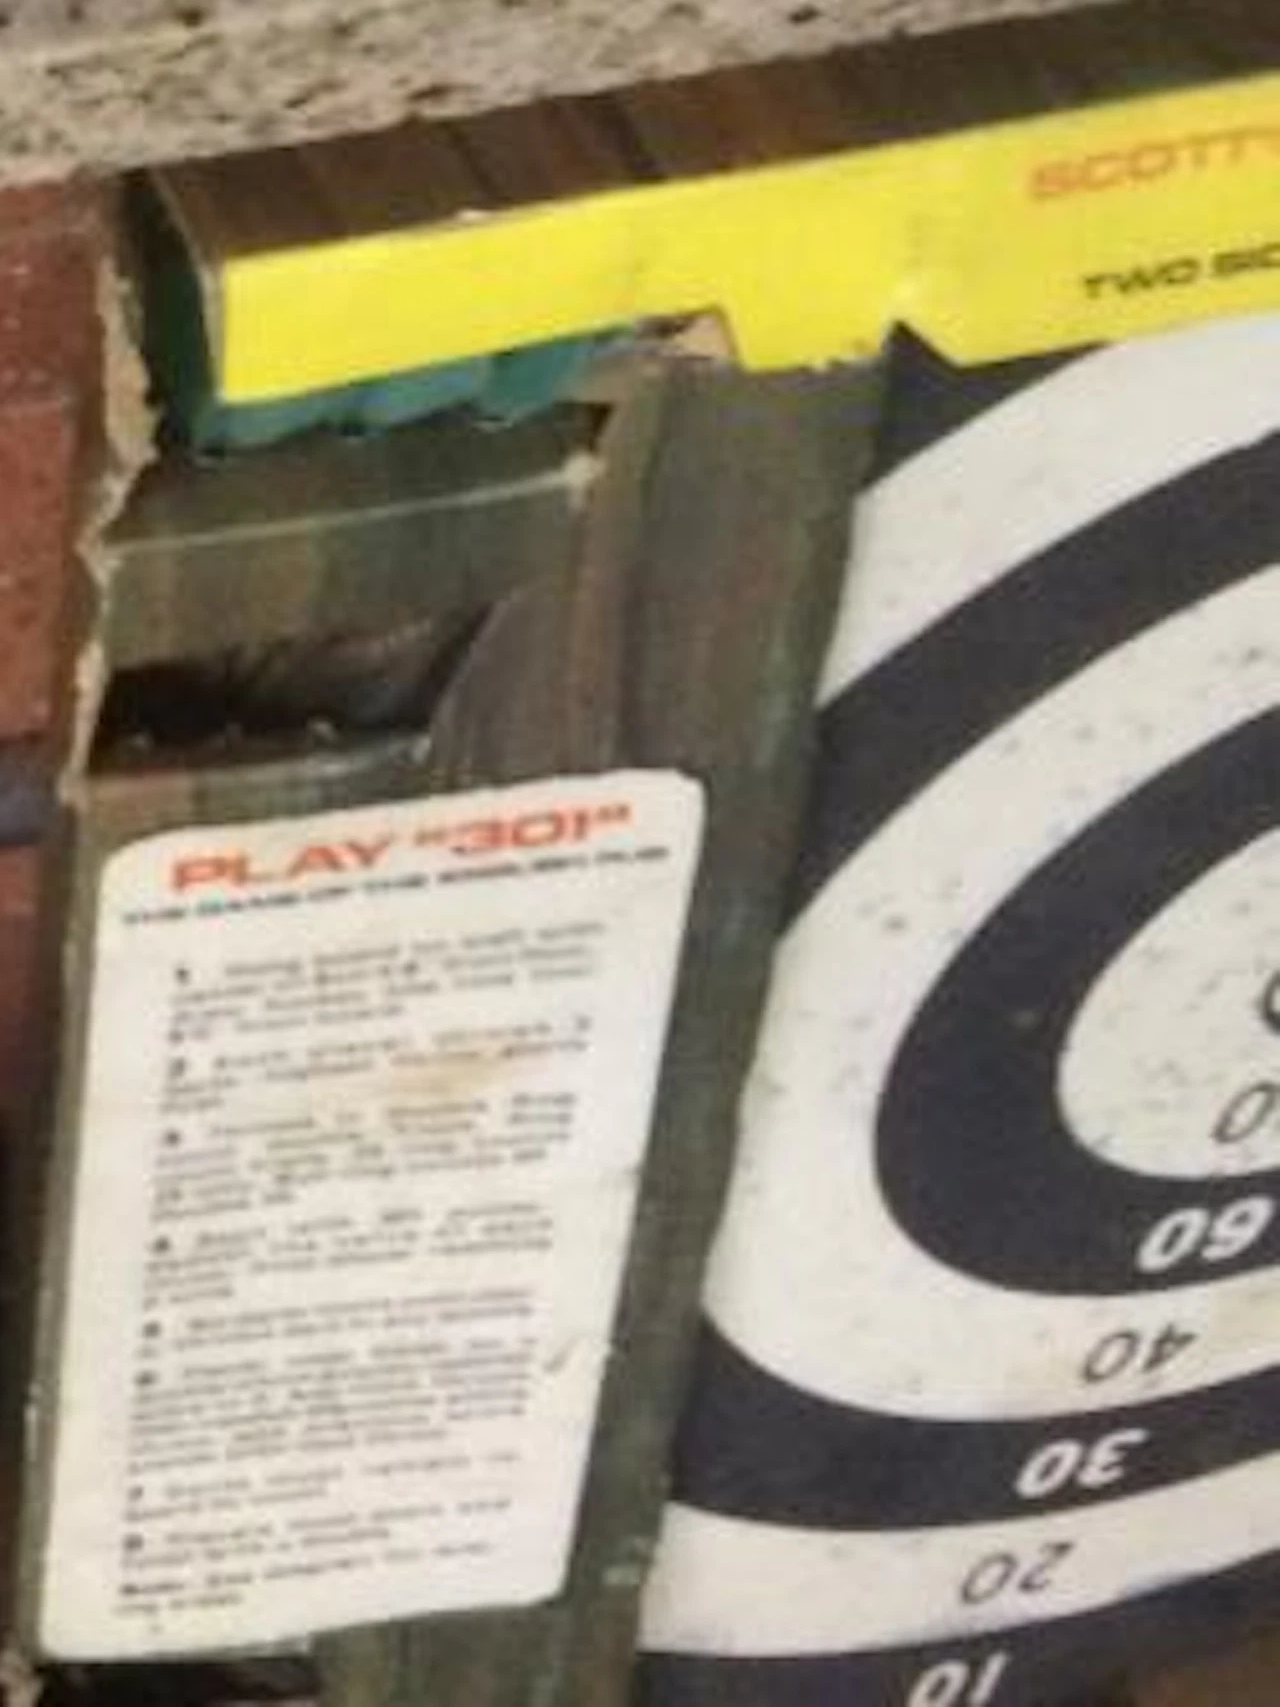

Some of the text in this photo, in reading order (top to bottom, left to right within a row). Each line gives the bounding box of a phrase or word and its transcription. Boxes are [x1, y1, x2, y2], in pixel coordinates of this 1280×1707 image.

[1084, 257, 1200, 300] TWO
[171, 837, 394, 894] PLAY
[1083, 1320, 1200, 1385] 40
[1016, 1428, 1150, 1498] 30
[961, 1541, 1076, 1606] 20
[906, 1653, 1013, 1707] 10
